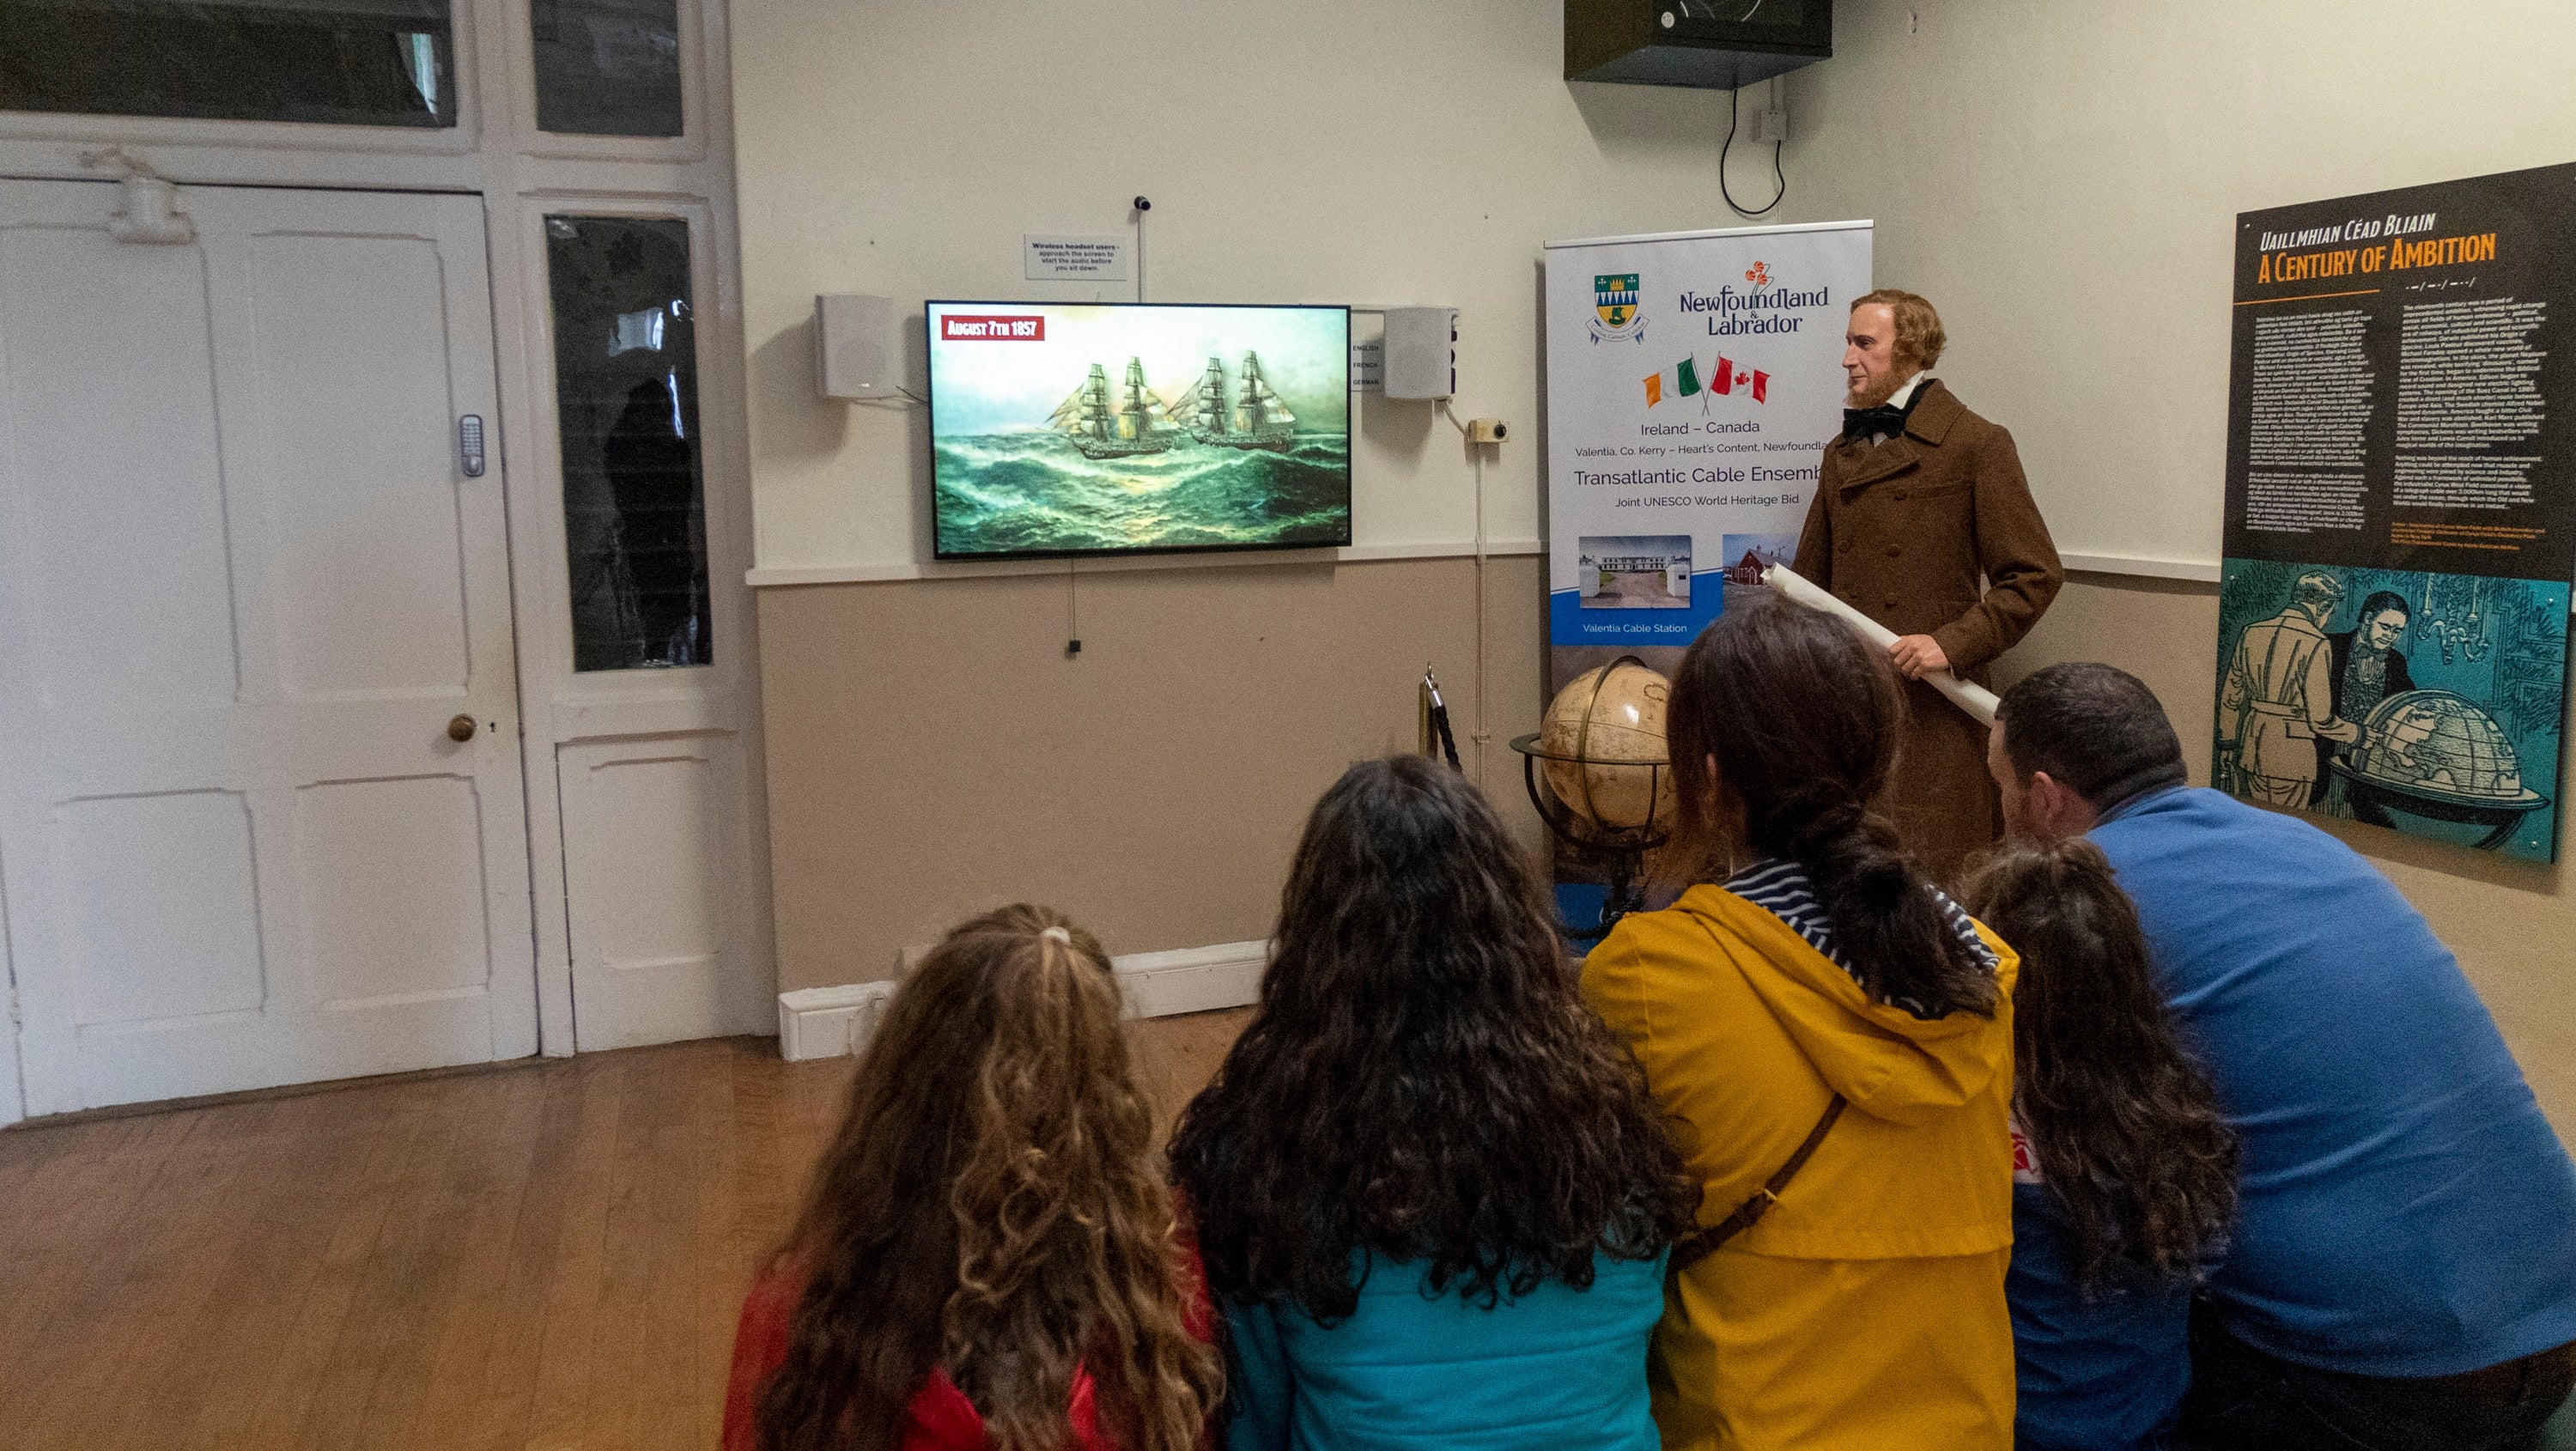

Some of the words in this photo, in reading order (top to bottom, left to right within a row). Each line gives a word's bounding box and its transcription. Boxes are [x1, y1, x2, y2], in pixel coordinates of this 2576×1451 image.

[2257, 254, 2271, 284] A
[1680, 285, 1829, 317] Newfoundland
[1750, 310, 1759, 319] &
[1012, 320, 1037, 337] 1857
[1708, 313, 1803, 336] Labrador
[1641, 422, 1689, 435] Ireland
[1706, 421, 1760, 434] Canada
[1576, 446, 1617, 457] Valentia,
[1620, 446, 1636, 456] Co.
[1639, 446, 1666, 457] Kerry
[1717, 443, 1760, 454] Content,
[1574, 468, 1686, 486] Transatlantic
[1692, 466, 1745, 483] Cable
[1615, 497, 1641, 507] Joint
[1643, 496, 1692, 507] UNESCO
[1694, 495, 1728, 506] World
[1730, 495, 1778, 507] Heritage
[1782, 494, 1800, 504] Bid
[1583, 623, 1621, 633] Valentia
[1623, 623, 1651, 633] Cable
[1654, 623, 1687, 633] Station
